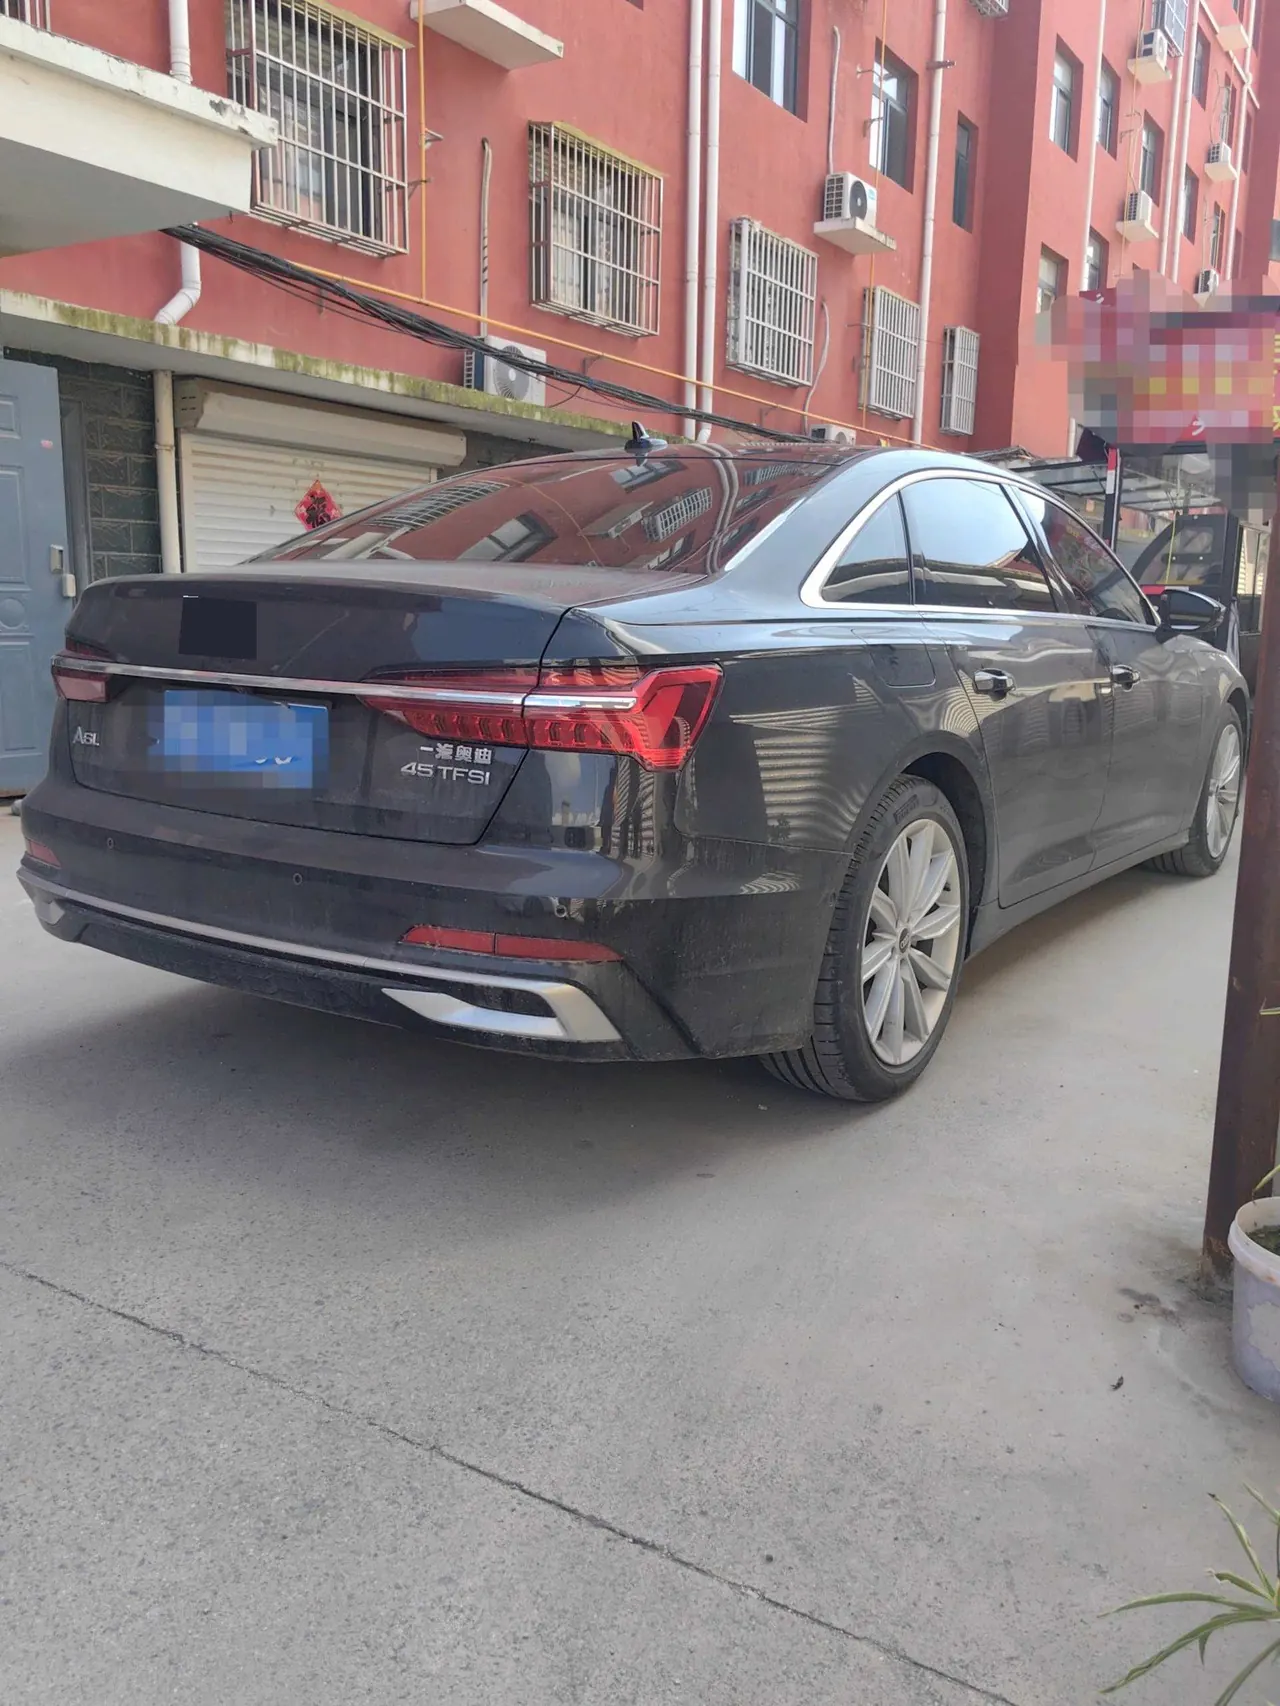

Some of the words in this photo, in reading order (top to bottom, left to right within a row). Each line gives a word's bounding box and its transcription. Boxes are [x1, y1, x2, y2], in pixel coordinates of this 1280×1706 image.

[72, 725, 100, 746] A6L
[400, 762, 434, 778] 45
[437, 765, 490, 785] TFSI
